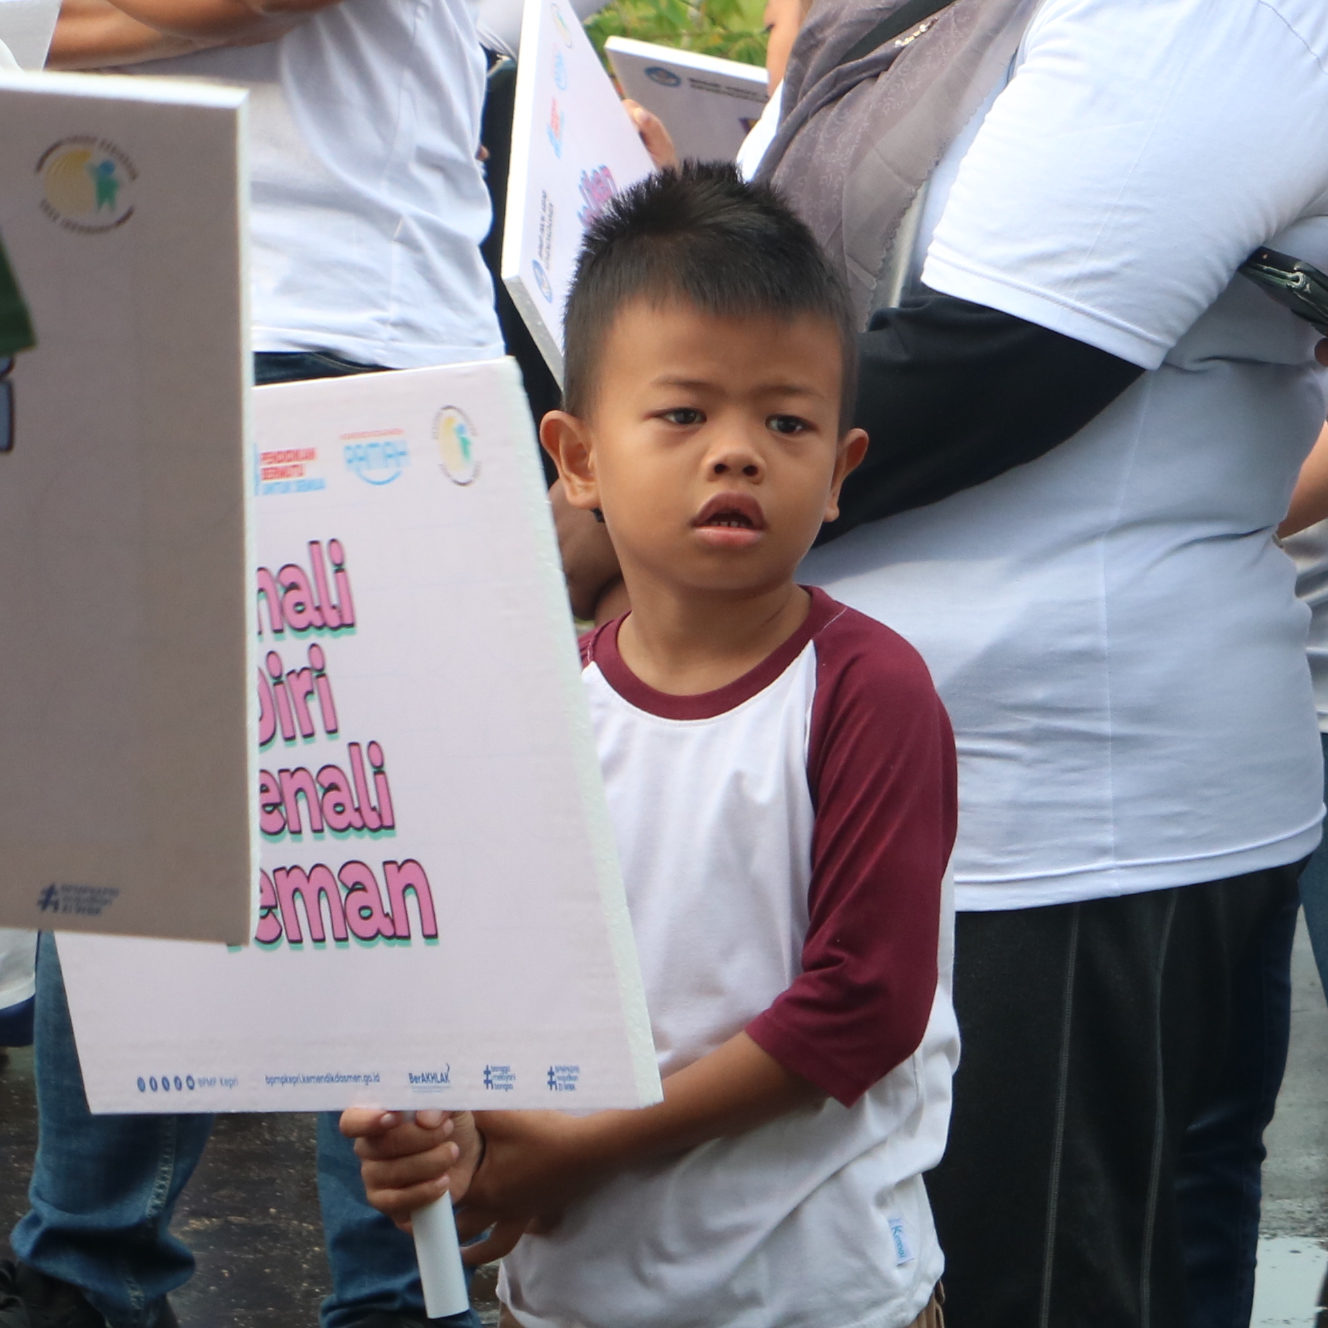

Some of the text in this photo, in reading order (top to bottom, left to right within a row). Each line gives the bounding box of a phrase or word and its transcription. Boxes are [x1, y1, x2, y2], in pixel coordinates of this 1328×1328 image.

[257, 538, 357, 637] nali
[259, 740, 396, 837] enali
[255, 857, 439, 947] eman
